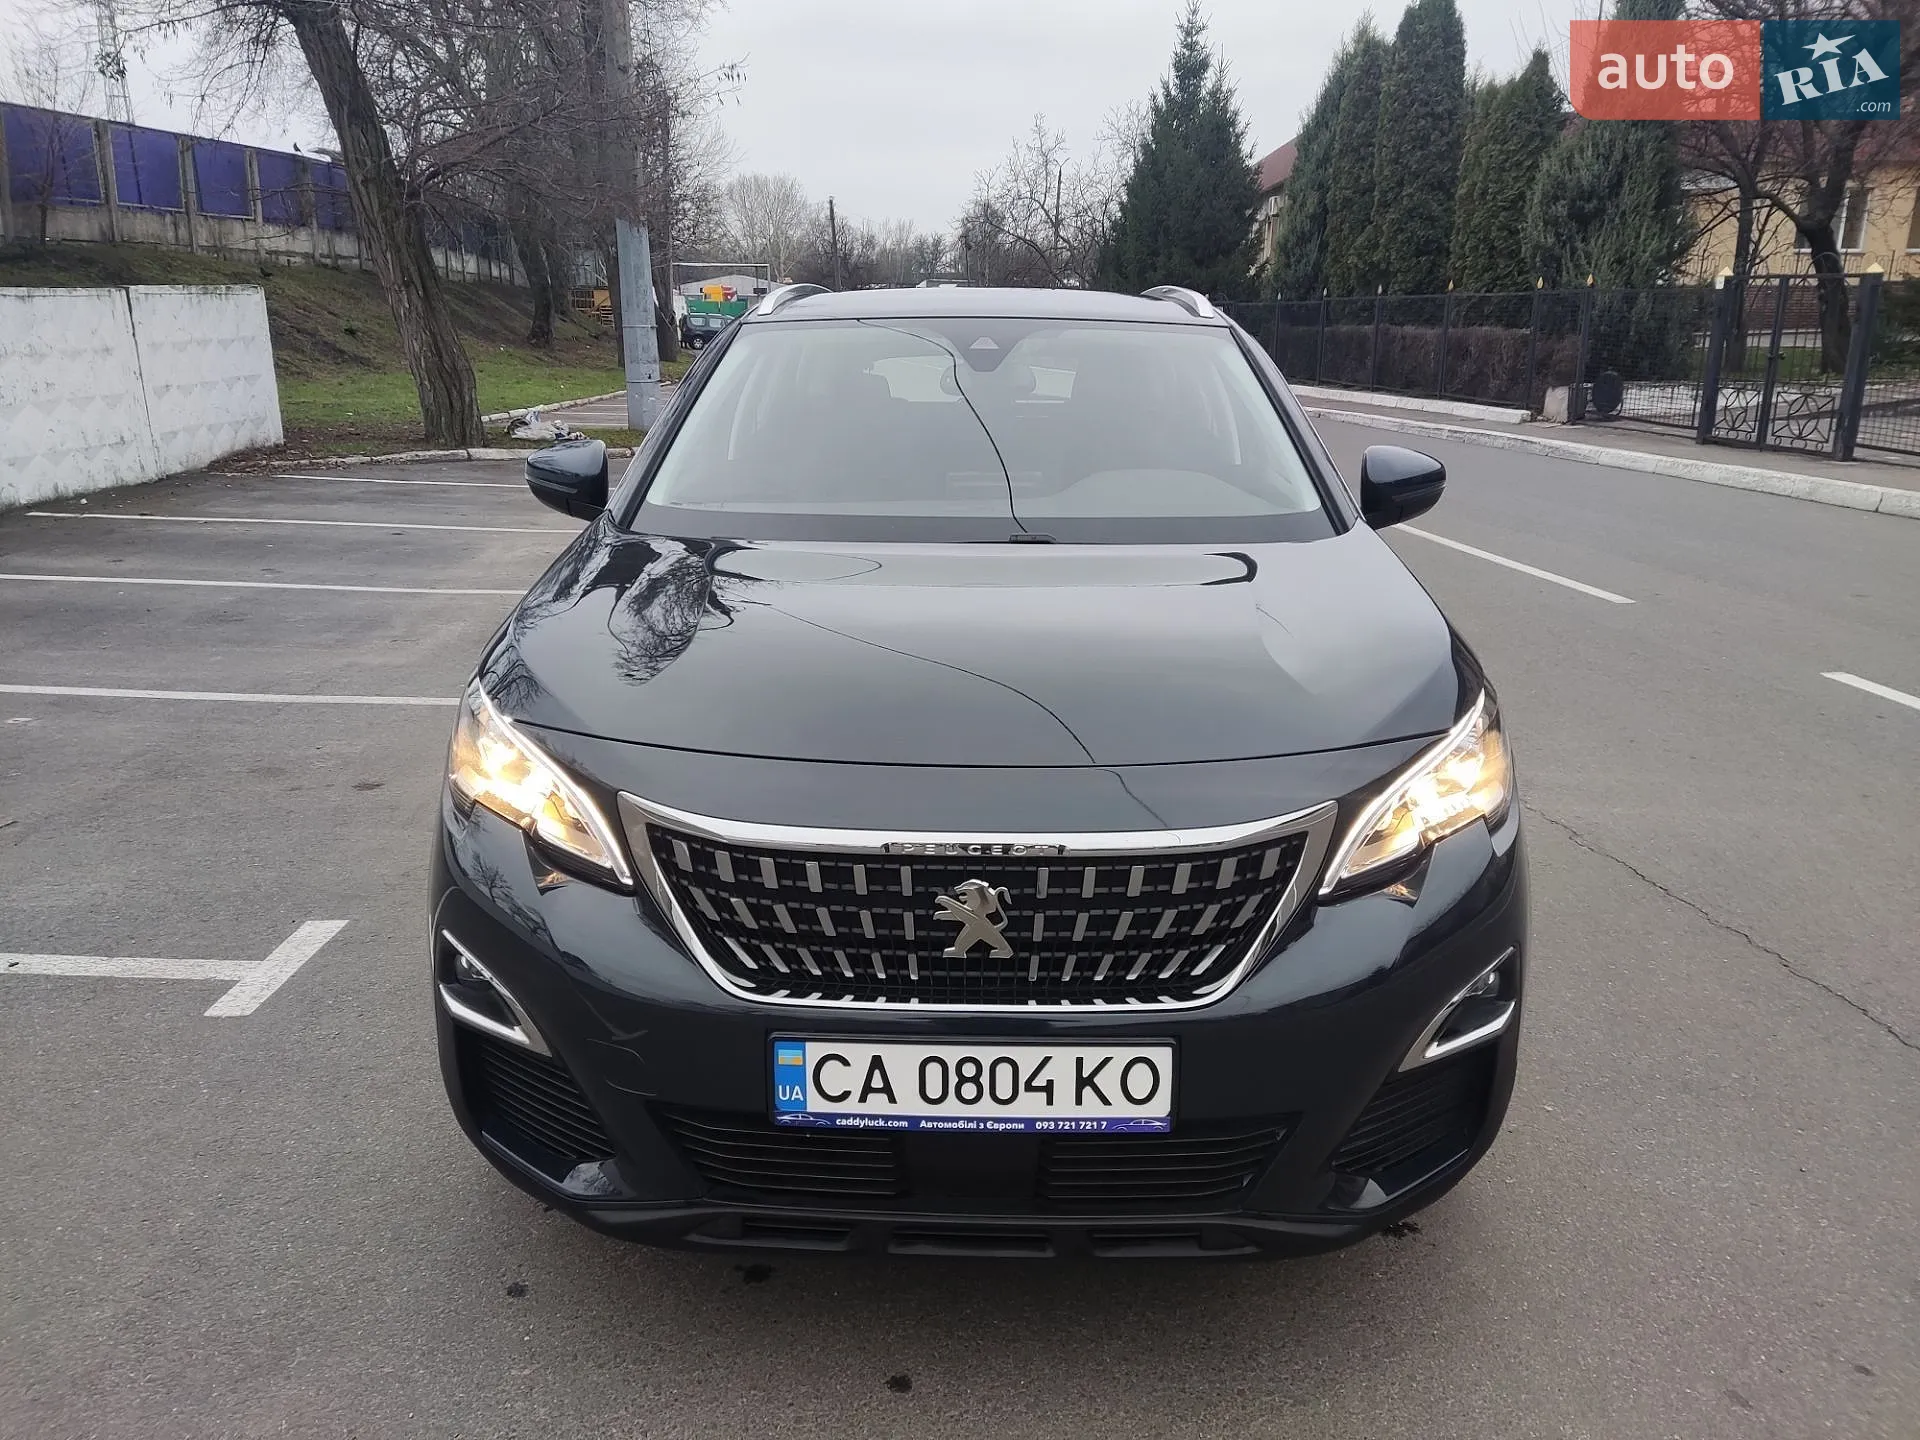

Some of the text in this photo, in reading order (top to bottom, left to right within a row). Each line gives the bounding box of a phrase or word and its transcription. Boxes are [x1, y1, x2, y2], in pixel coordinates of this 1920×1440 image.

[811, 1053, 1161, 1107] CA 0804 KO
[778, 1085, 804, 1101] UA
[835, 1117, 909, 1129] caddyluck.com
[919, 1119, 1025, 1131] Автомобілі з Європи
[1035, 1121, 1107, 1130] 093 721 721 7
